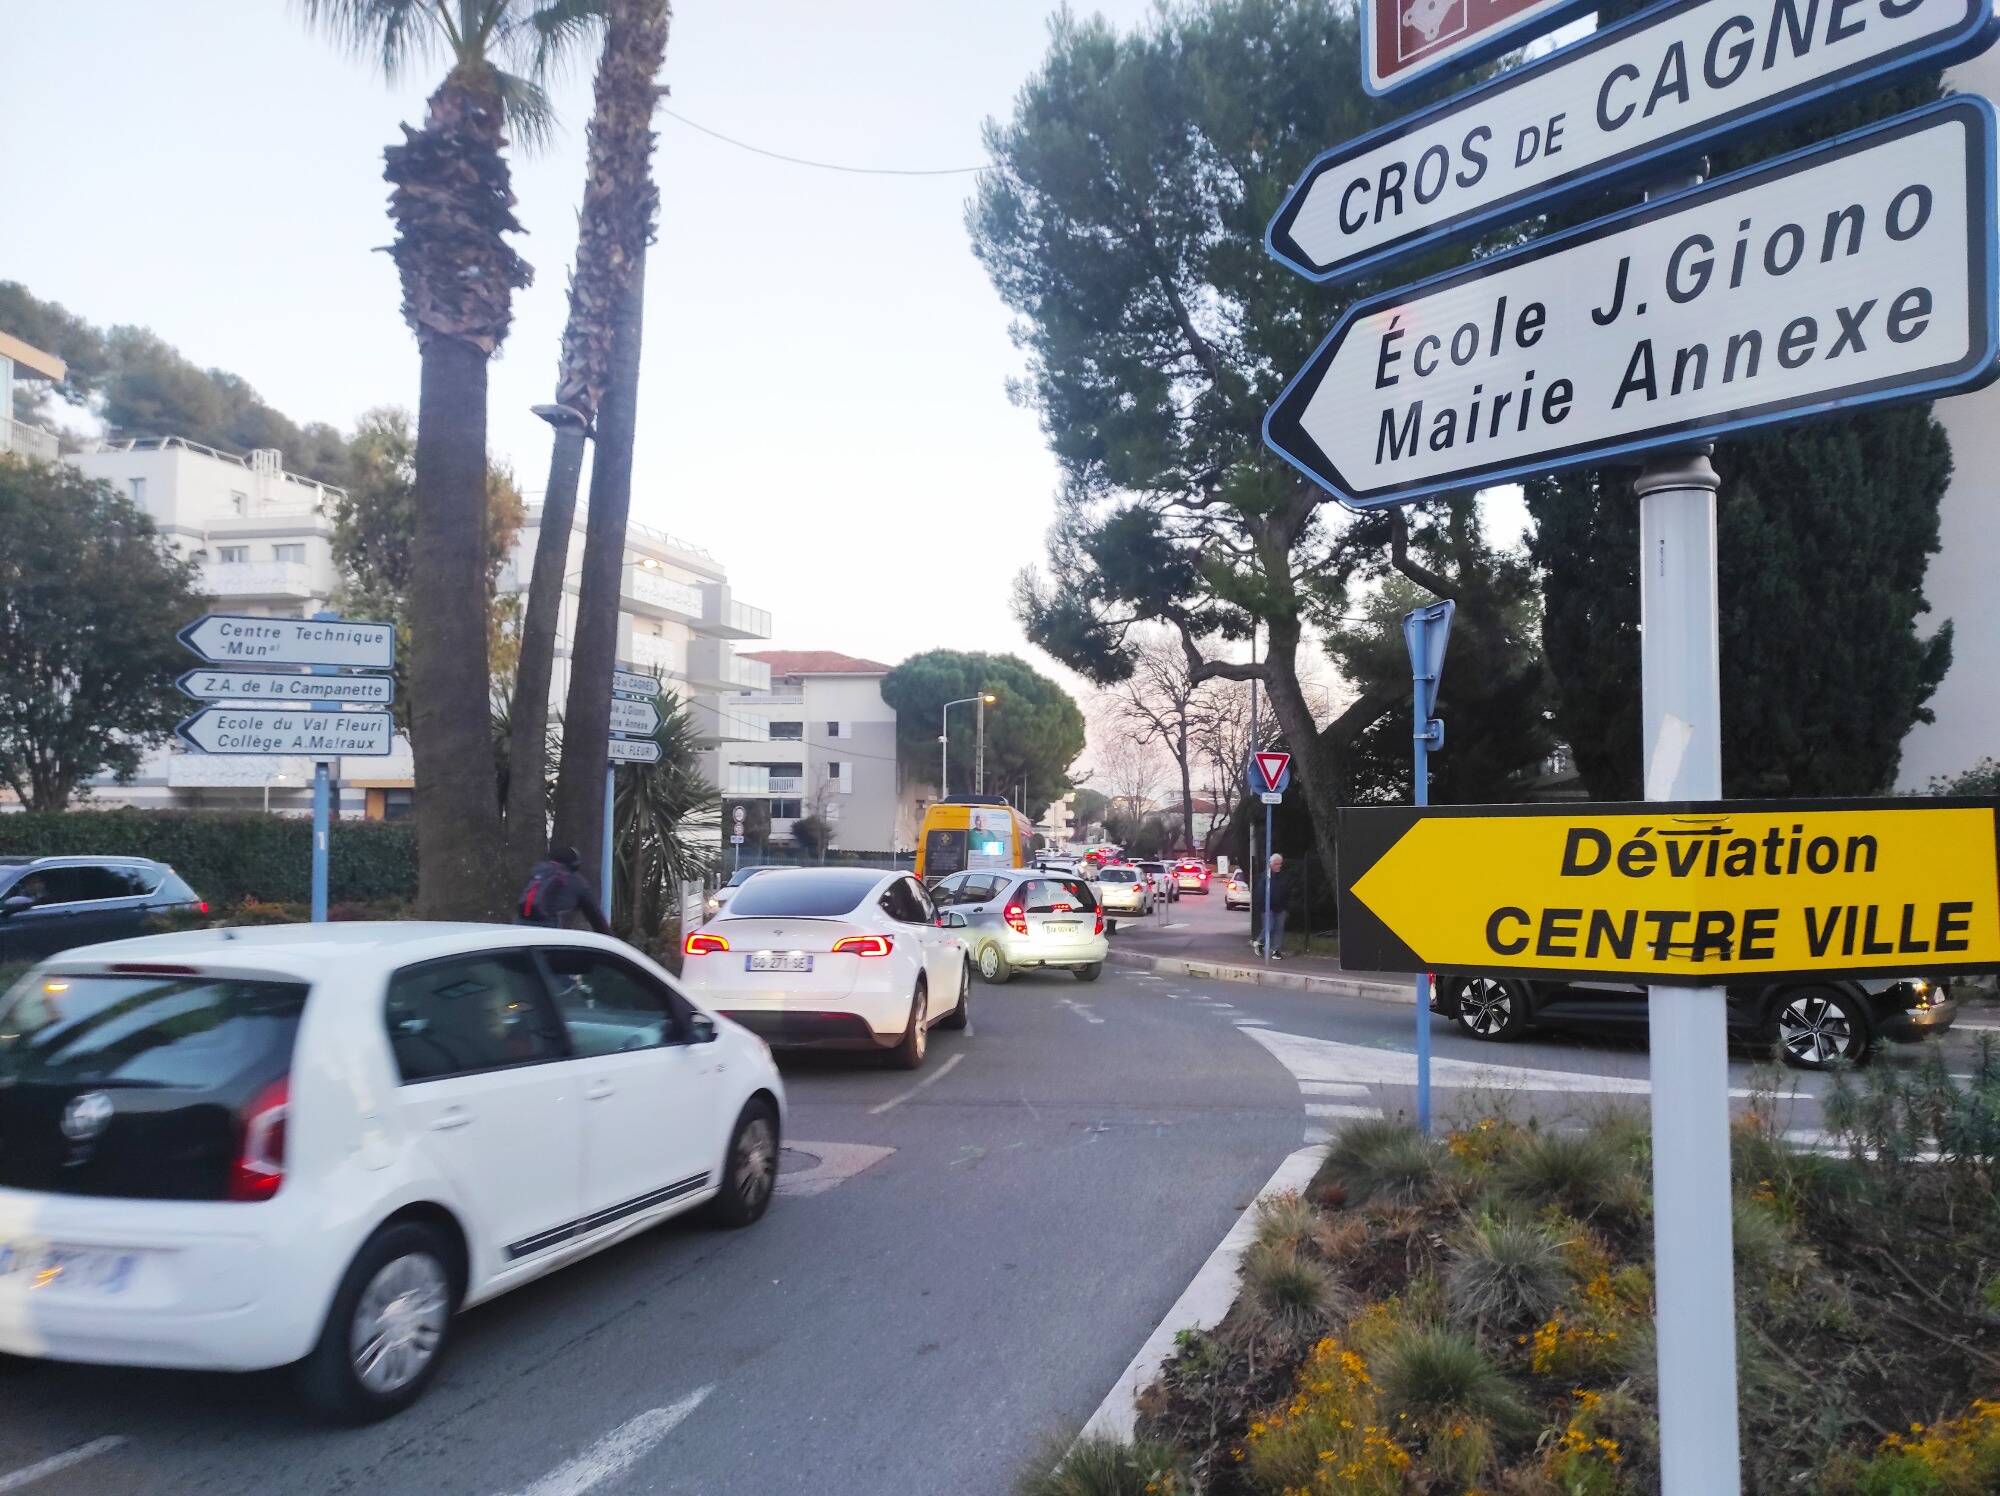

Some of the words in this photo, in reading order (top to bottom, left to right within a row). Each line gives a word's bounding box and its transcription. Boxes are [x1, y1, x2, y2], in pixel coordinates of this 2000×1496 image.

[1338, 125, 1492, 236] CROS
[1513, 113, 1567, 170] DE
[1596, 0, 1925, 132] CAGNE
[1374, 295, 1547, 391] École
[1374, 368, 1575, 466] Mairie
[1610, 286, 1934, 411] Annexe
[220, 623, 281, 639] Centre
[296, 626, 383, 644] Technique
[242, 679, 261, 693] de
[270, 680, 284, 694] la
[290, 681, 382, 698] Campanette
[217, 716, 263, 729] Ecole
[273, 717, 293, 730] du
[304, 718, 327, 731] Val
[335, 719, 382, 732] Fleuri
[1560, 823, 1879, 879] Déviation
[1485, 906, 1781, 963] CENTRE
[1803, 900, 1974, 958] VILLE
